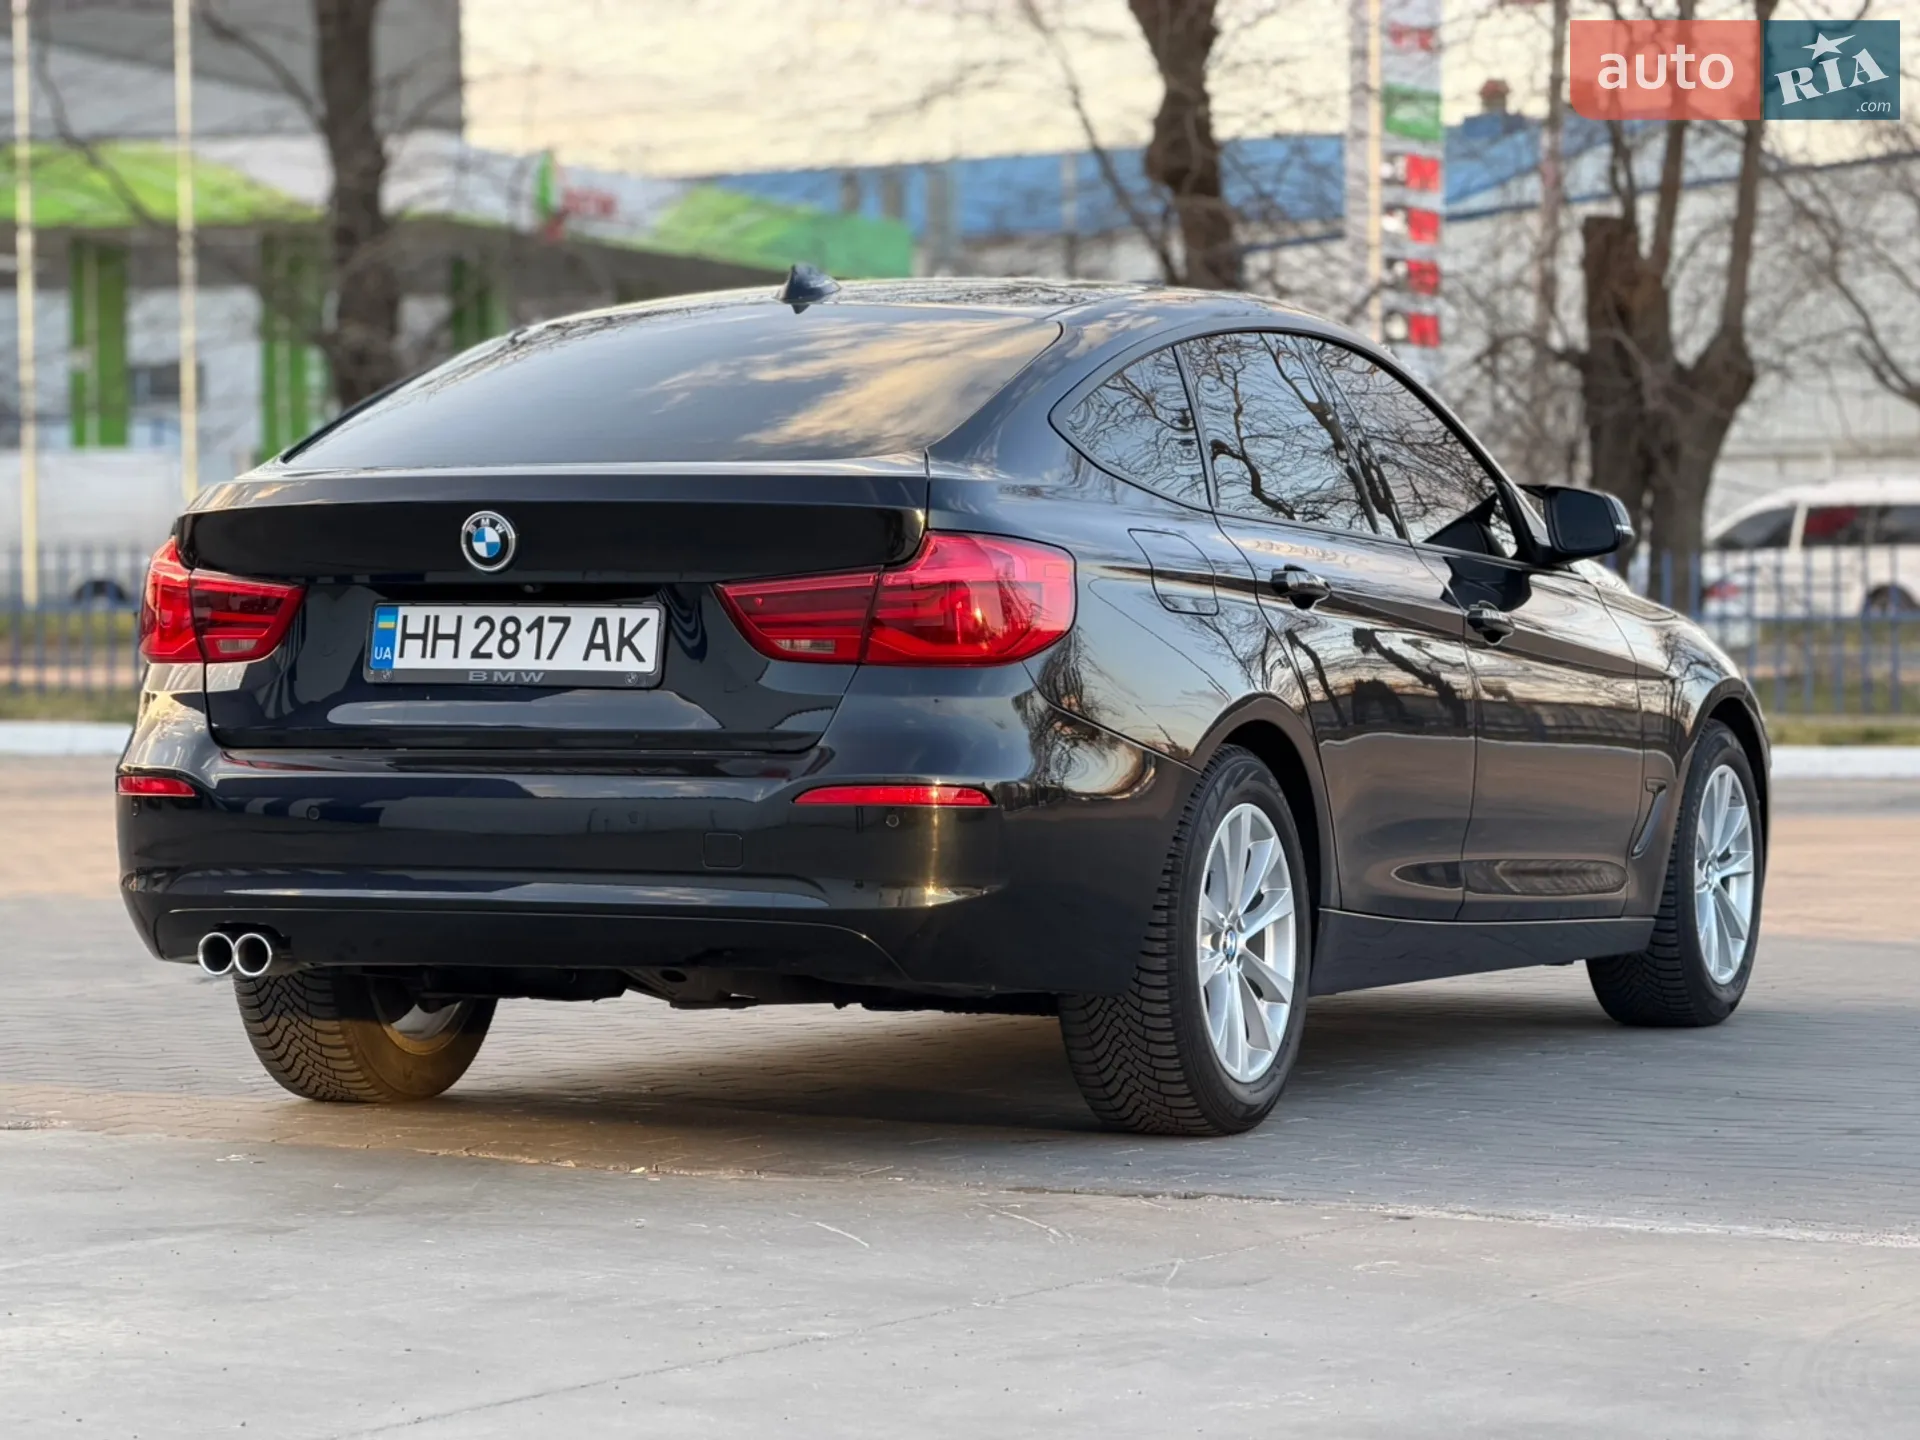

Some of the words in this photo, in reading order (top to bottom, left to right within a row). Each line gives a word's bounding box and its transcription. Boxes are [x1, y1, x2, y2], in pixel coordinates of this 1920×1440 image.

[466, 518, 506, 534] BMW
[398, 614, 463, 659] HH
[470, 615, 572, 661] 2817
[582, 616, 650, 663] AK
[374, 647, 392, 660] UA
[468, 671, 545, 683] BMW
